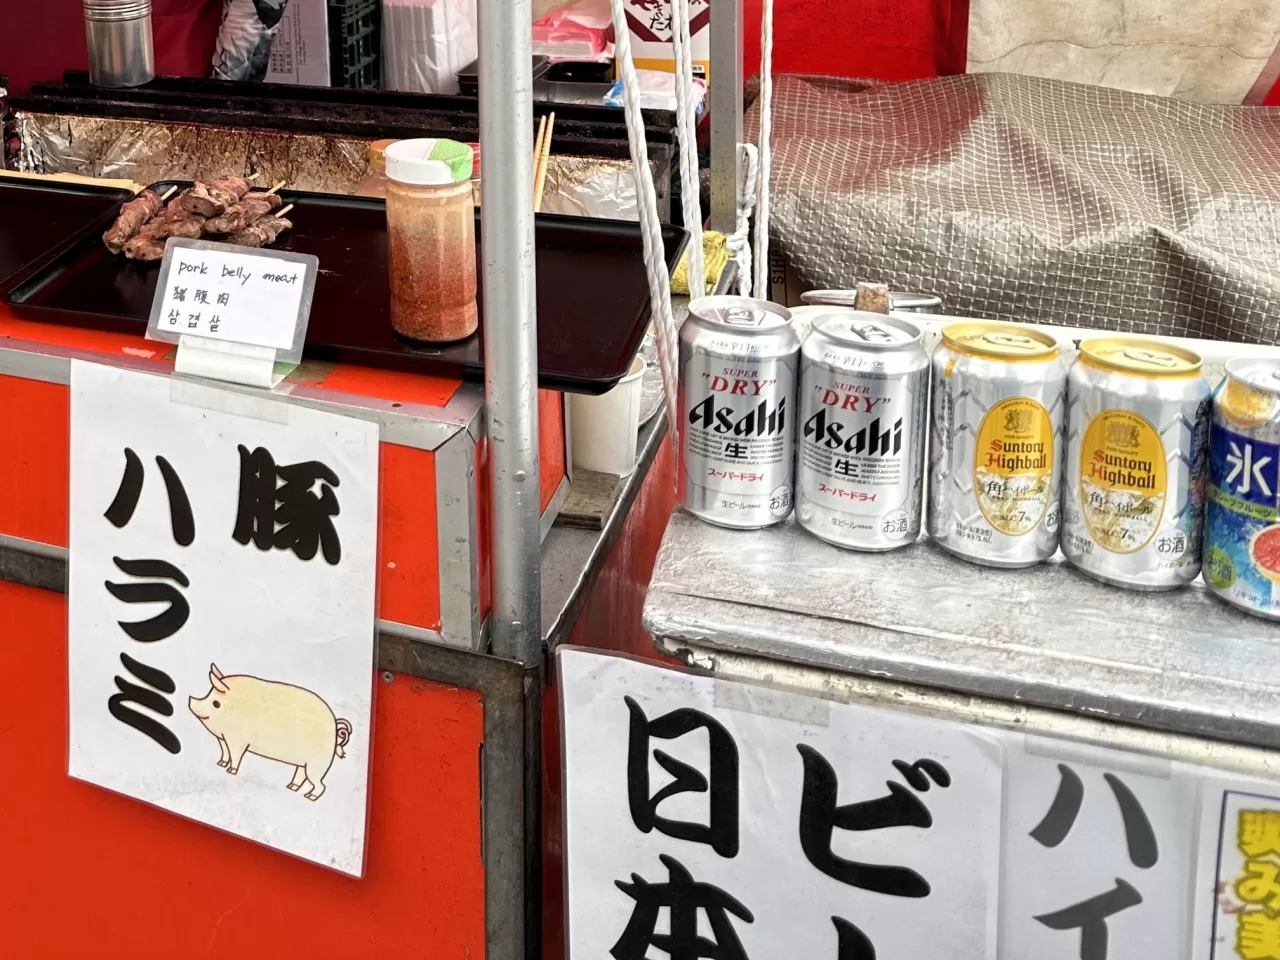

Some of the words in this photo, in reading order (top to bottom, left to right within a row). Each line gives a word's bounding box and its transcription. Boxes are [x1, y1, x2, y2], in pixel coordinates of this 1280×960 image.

[177, 260, 209, 276] pork
[221, 263, 252, 286] belly
[262, 272, 299, 285] meat
[167, 308, 222, 333] 삼겹살
[722, 367, 759, 378] SUPER
[832, 380, 871, 395] SUPER
[688, 393, 787, 438] Asahi
[803, 407, 904, 457] Asahi
[724, 442, 749, 460] 生
[989, 438, 1045, 454] Suntory
[834, 458, 859, 478] 生
[983, 451, 1048, 473] Highball
[1093, 448, 1153, 473] Suntory
[708, 467, 765, 482] スーパードライ
[1087, 461, 1157, 490] Highball
[769, 492, 789, 510] お酒
[818, 482, 878, 502] スーパードライ
[231, 442, 343, 567] 豚
[882, 517, 909, 533] お酒
[1157, 536, 1185, 553] お酒
[102, 445, 197, 756] ハラミ
[1029, 763, 1160, 960] ハイ
